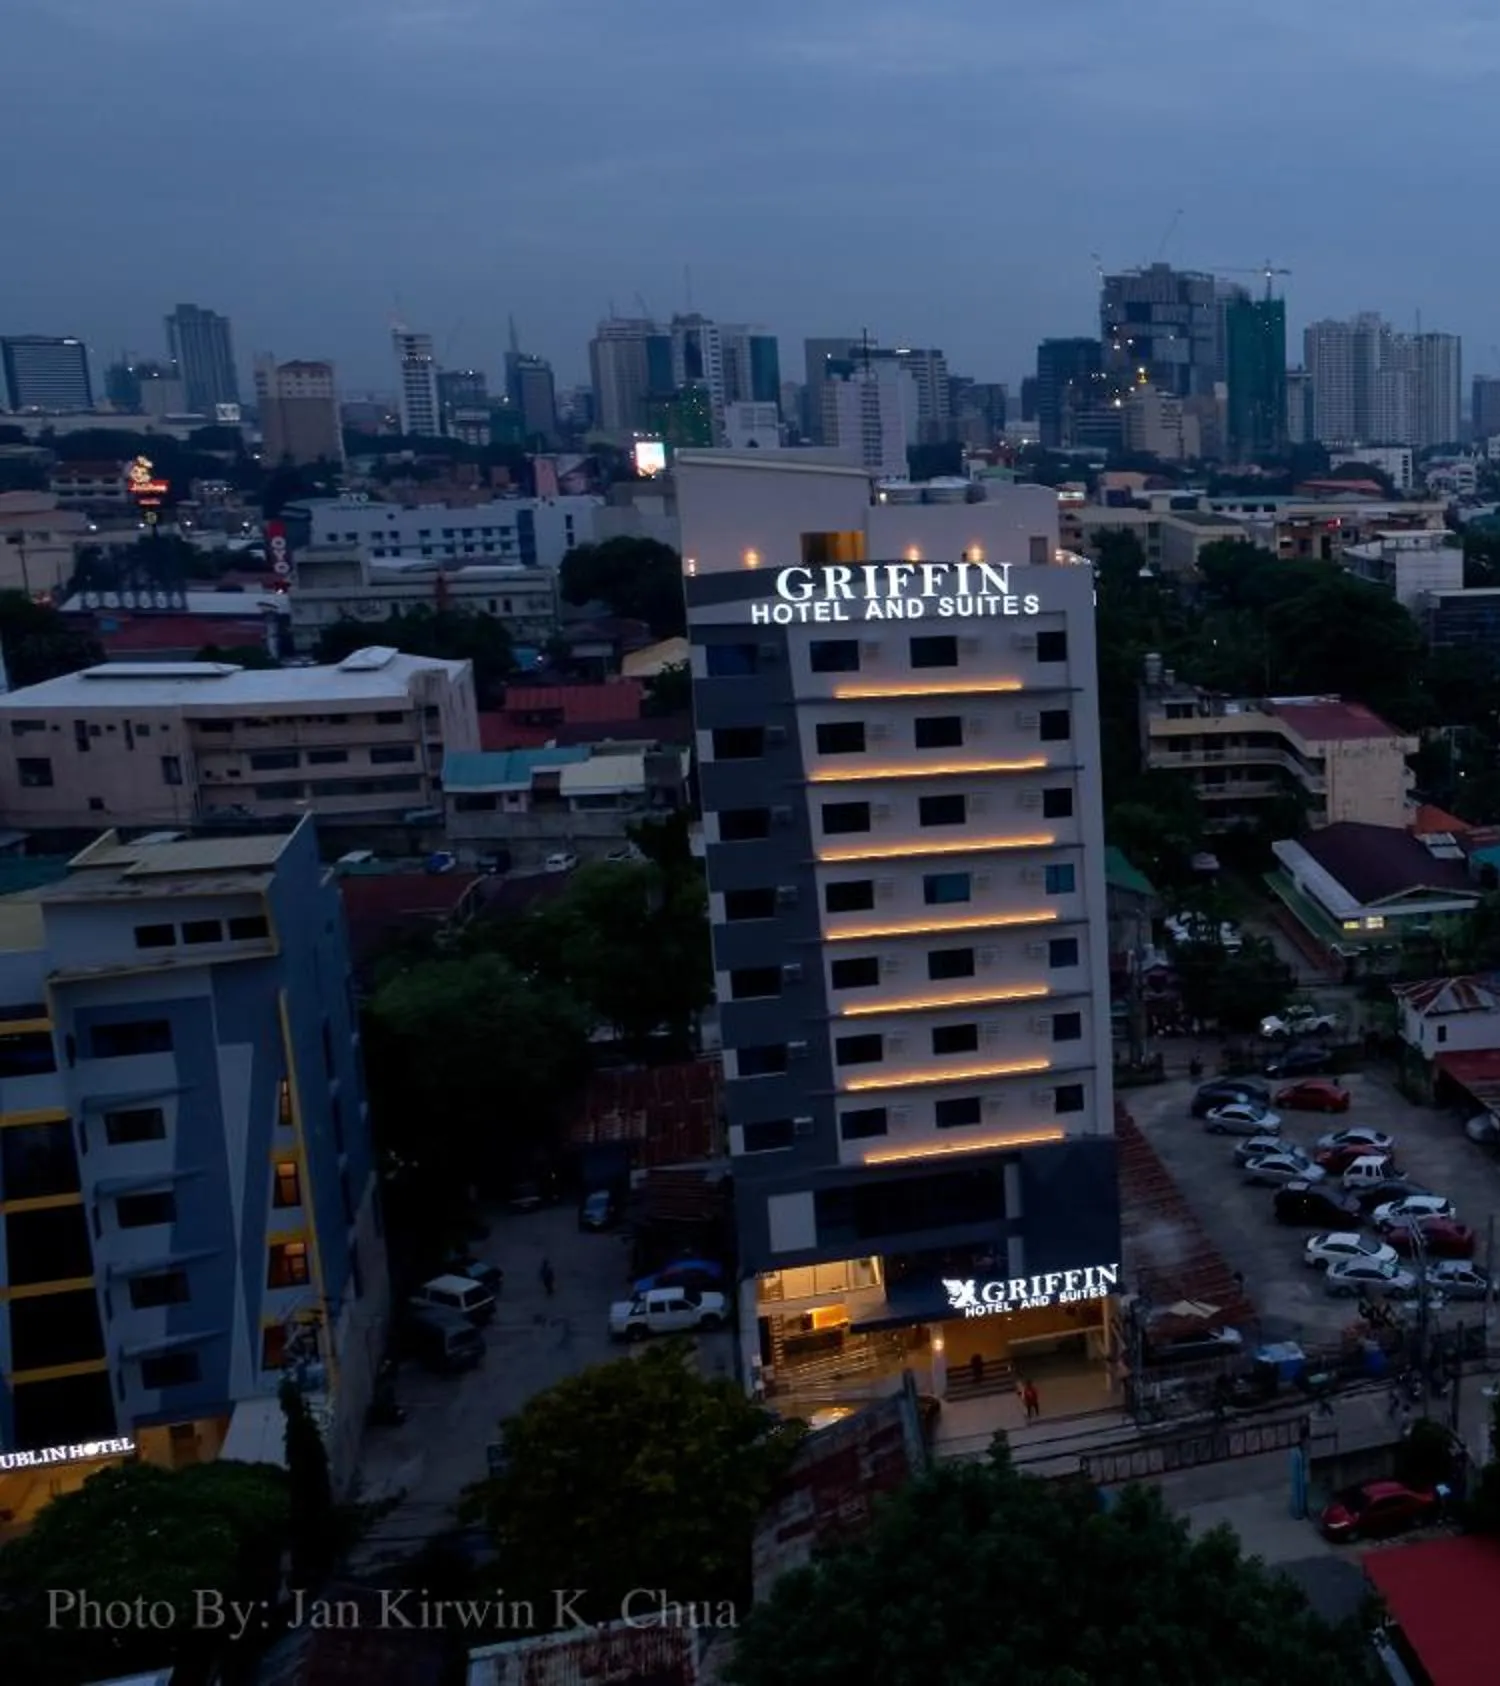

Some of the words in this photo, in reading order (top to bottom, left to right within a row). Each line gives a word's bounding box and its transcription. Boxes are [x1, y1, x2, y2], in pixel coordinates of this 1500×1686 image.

[270, 535, 290, 574] OYO
[776, 562, 1013, 601] GRIFFIN
[751, 601, 849, 625] HOTEL
[865, 597, 924, 620] AND
[938, 594, 1041, 616] SUITES
[981, 1263, 1119, 1303] GRIFFIN
[964, 1301, 1013, 1318] HOTEL
[1020, 1295, 1050, 1310] AND
[1059, 1285, 1108, 1303] SUITES
[70, 1437, 135, 1458] HOTEL
